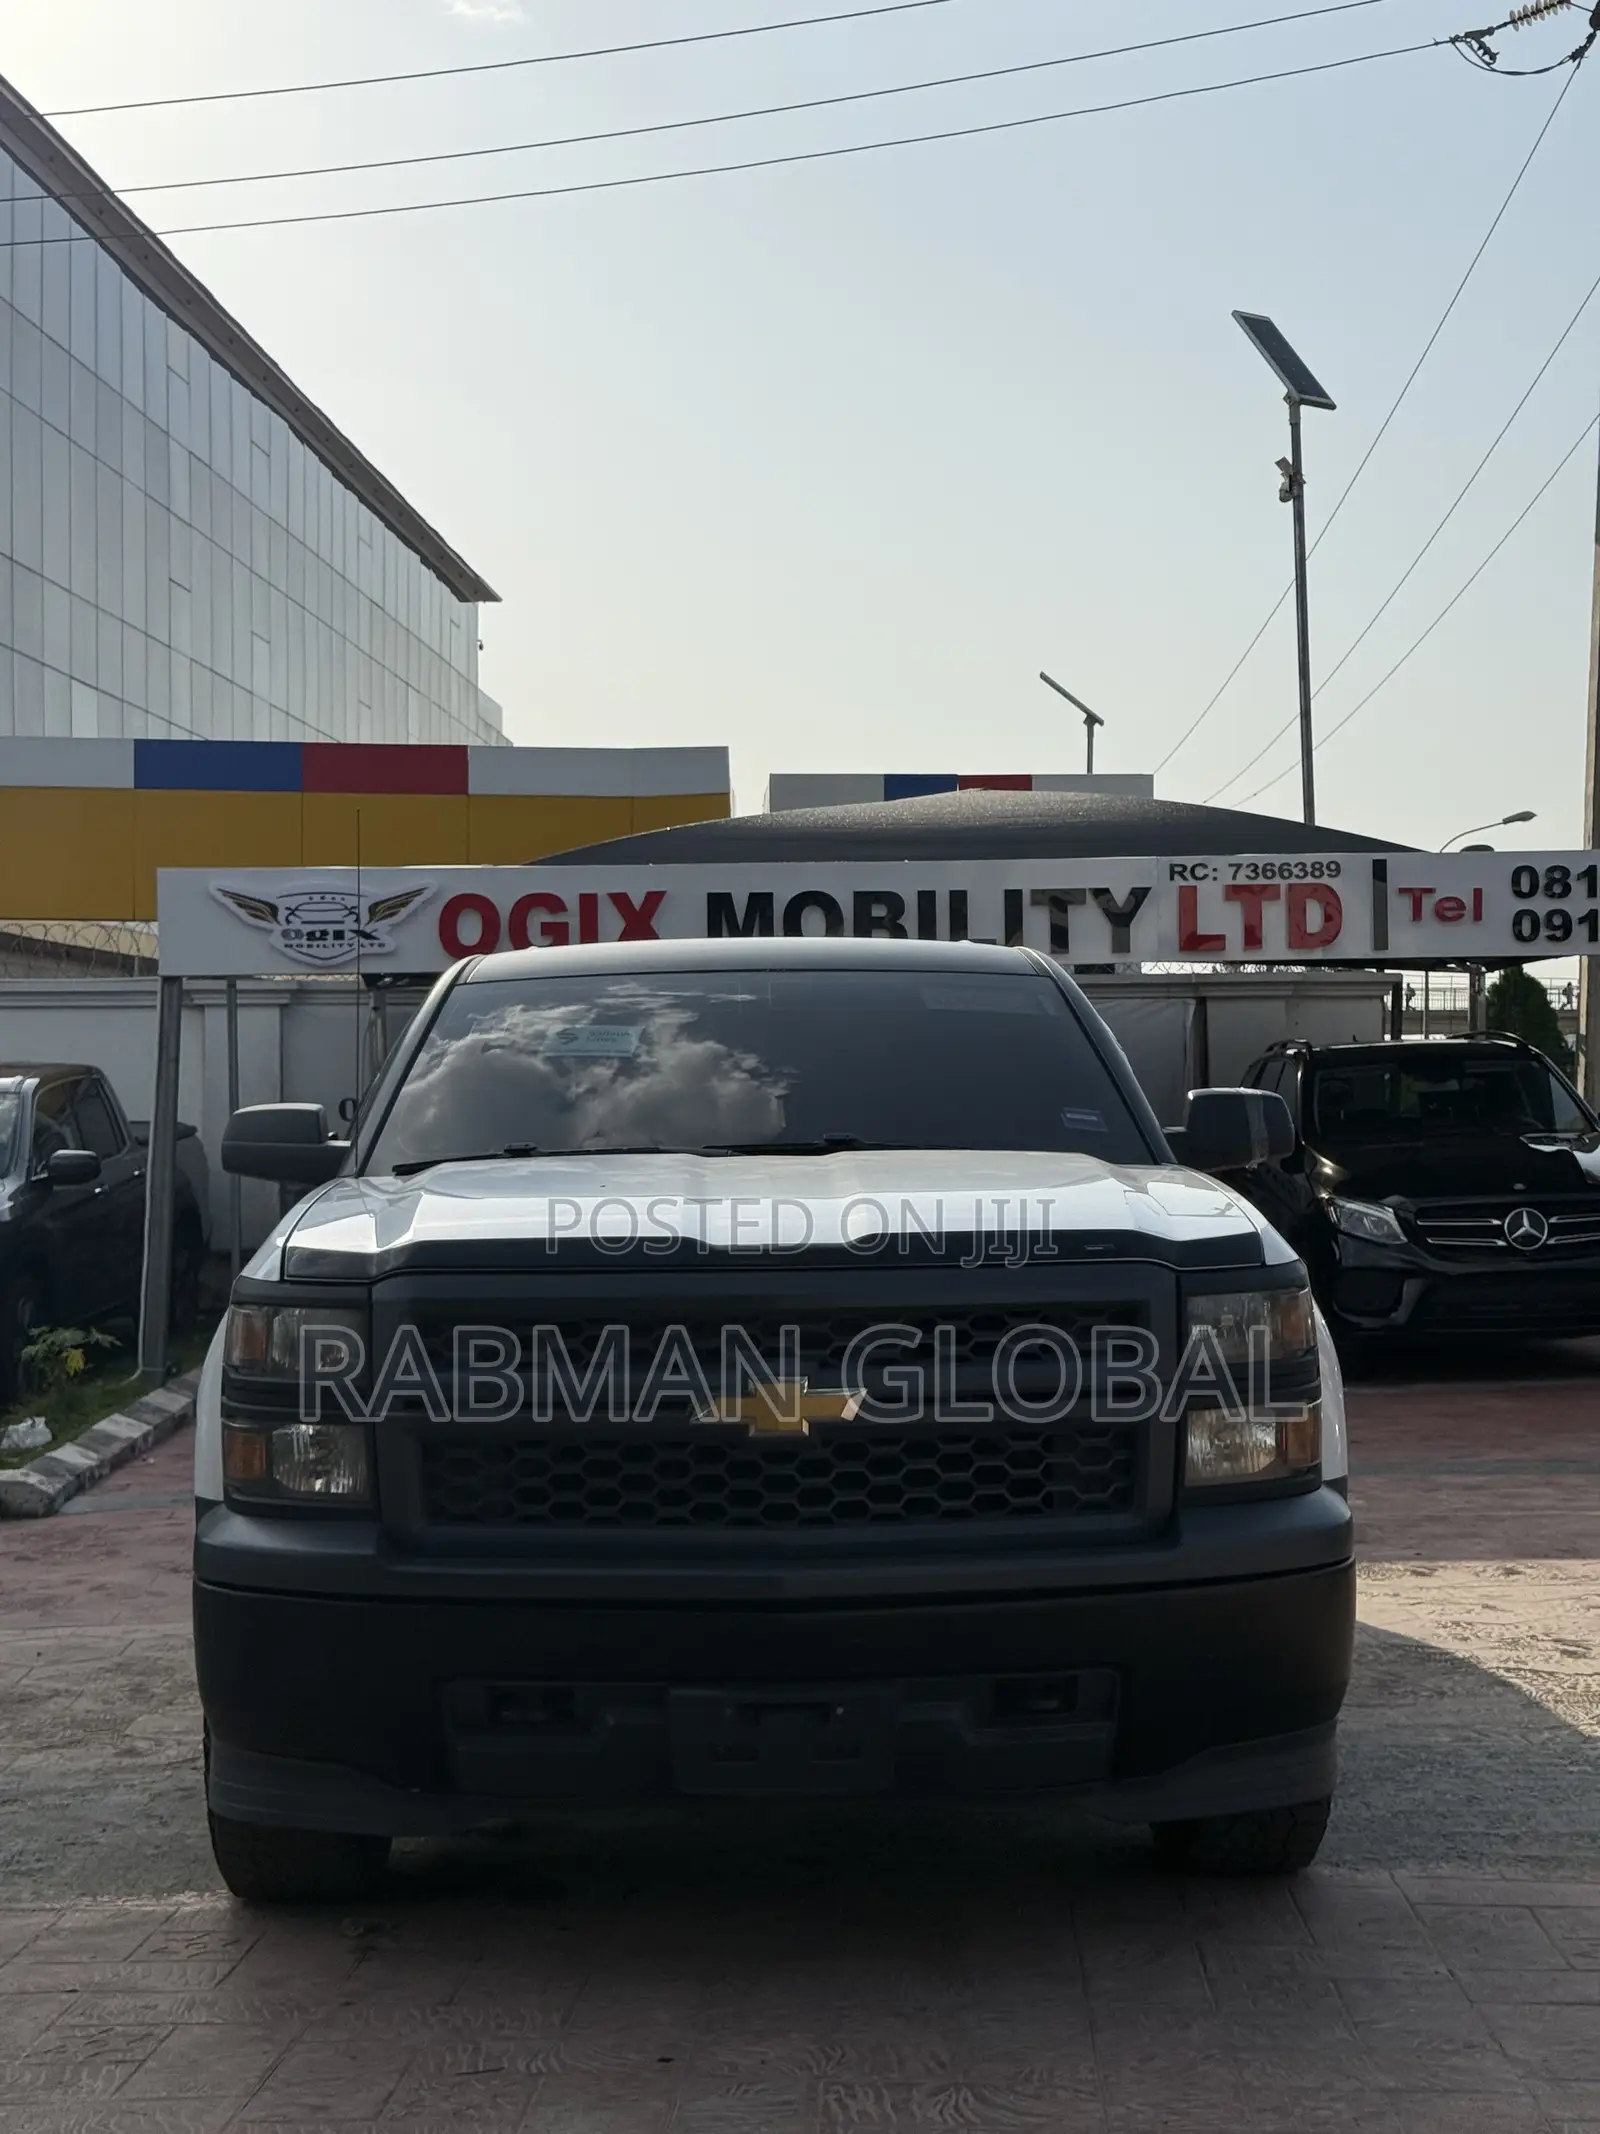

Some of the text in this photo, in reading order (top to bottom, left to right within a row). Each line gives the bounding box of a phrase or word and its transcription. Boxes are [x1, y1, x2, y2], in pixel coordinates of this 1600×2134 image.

[1169, 860, 1342, 882] RC: 7366389
[1398, 864, 1598, 923] Tel 081
[439, 882, 1343, 959] OGIX MOBILITY LTD
[1512, 908, 1599, 942] 091
